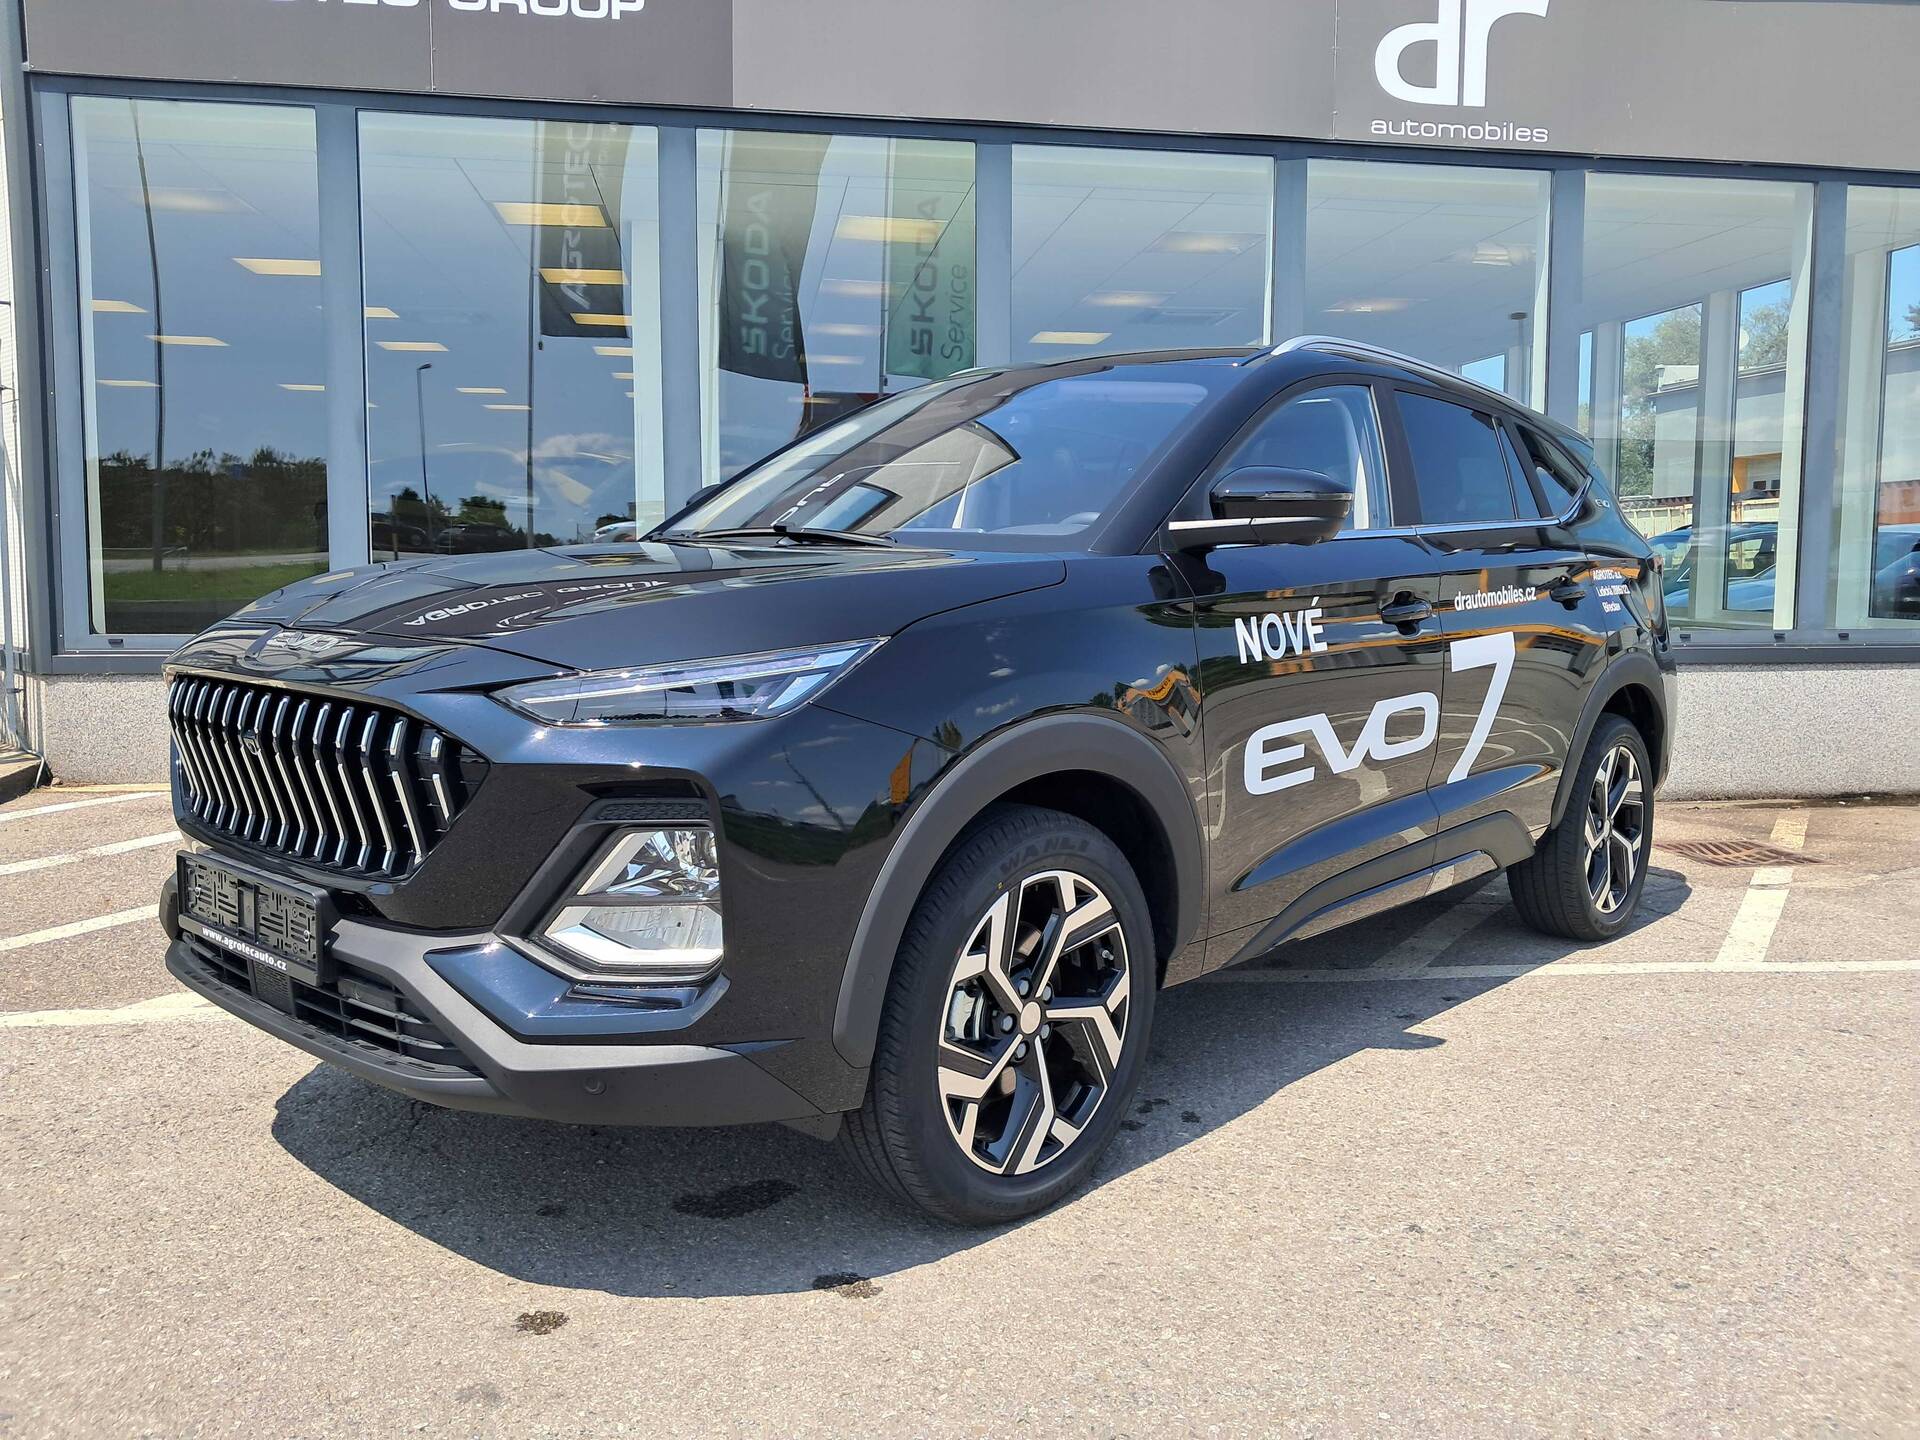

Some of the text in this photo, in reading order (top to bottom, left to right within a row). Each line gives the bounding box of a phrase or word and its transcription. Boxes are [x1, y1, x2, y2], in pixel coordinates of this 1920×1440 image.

[1371, 119, 1549, 142] automobiles
[940, 263, 968, 362] Service
[1454, 585, 1537, 611] drautomobiles.cz
[1234, 597, 1328, 664] NOVÉ
[1244, 631, 1515, 795] EVO 7
[202, 927, 287, 971] www.agrotecauto.cz
